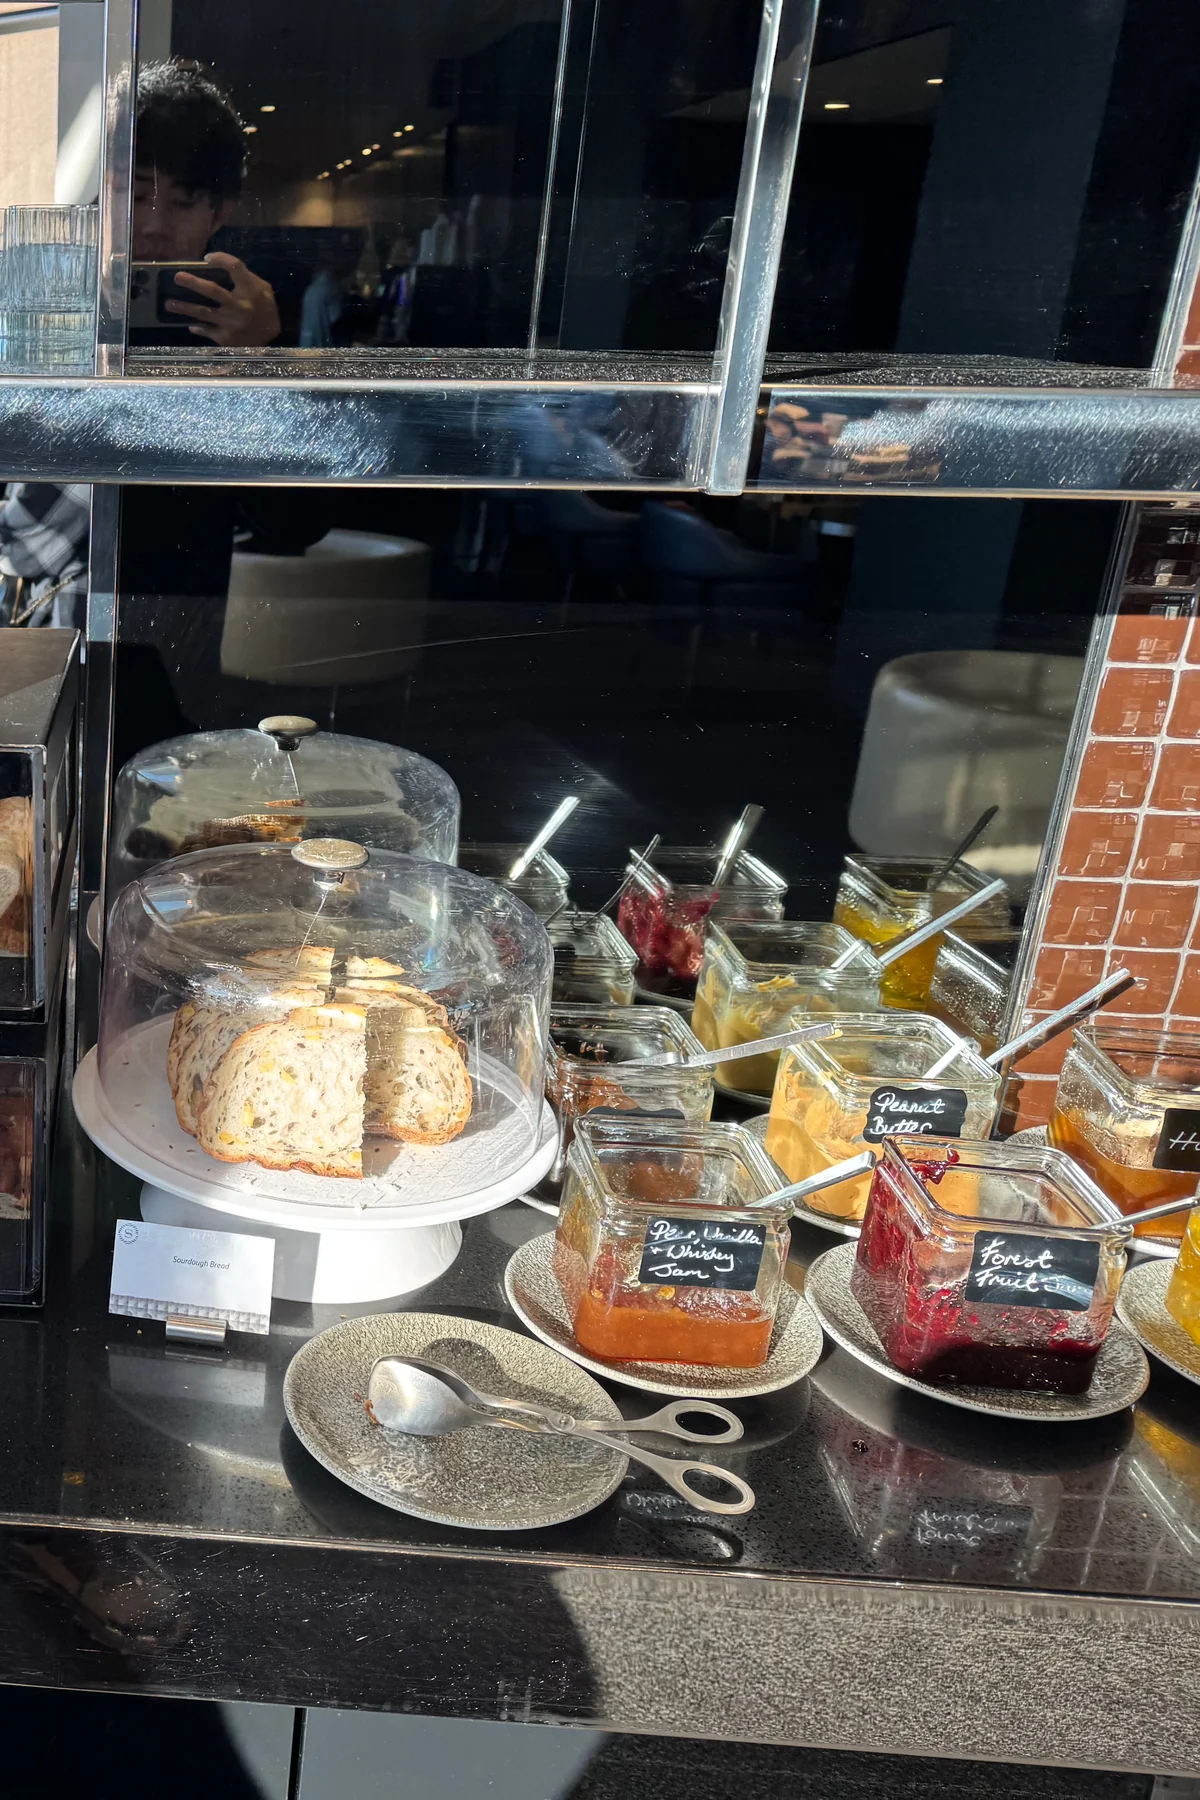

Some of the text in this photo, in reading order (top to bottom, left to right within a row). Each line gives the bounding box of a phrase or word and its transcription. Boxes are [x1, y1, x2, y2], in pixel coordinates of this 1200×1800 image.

[875, 1092, 945, 1114] Peanut
[870, 1116, 932, 1134] Butter
[172, 1255, 230, 1270] Sourdough Bread
[980, 1237, 1053, 1269] Forest
[648, 1262, 710, 1279] Jam
[975, 1265, 1039, 1292] Fruit
